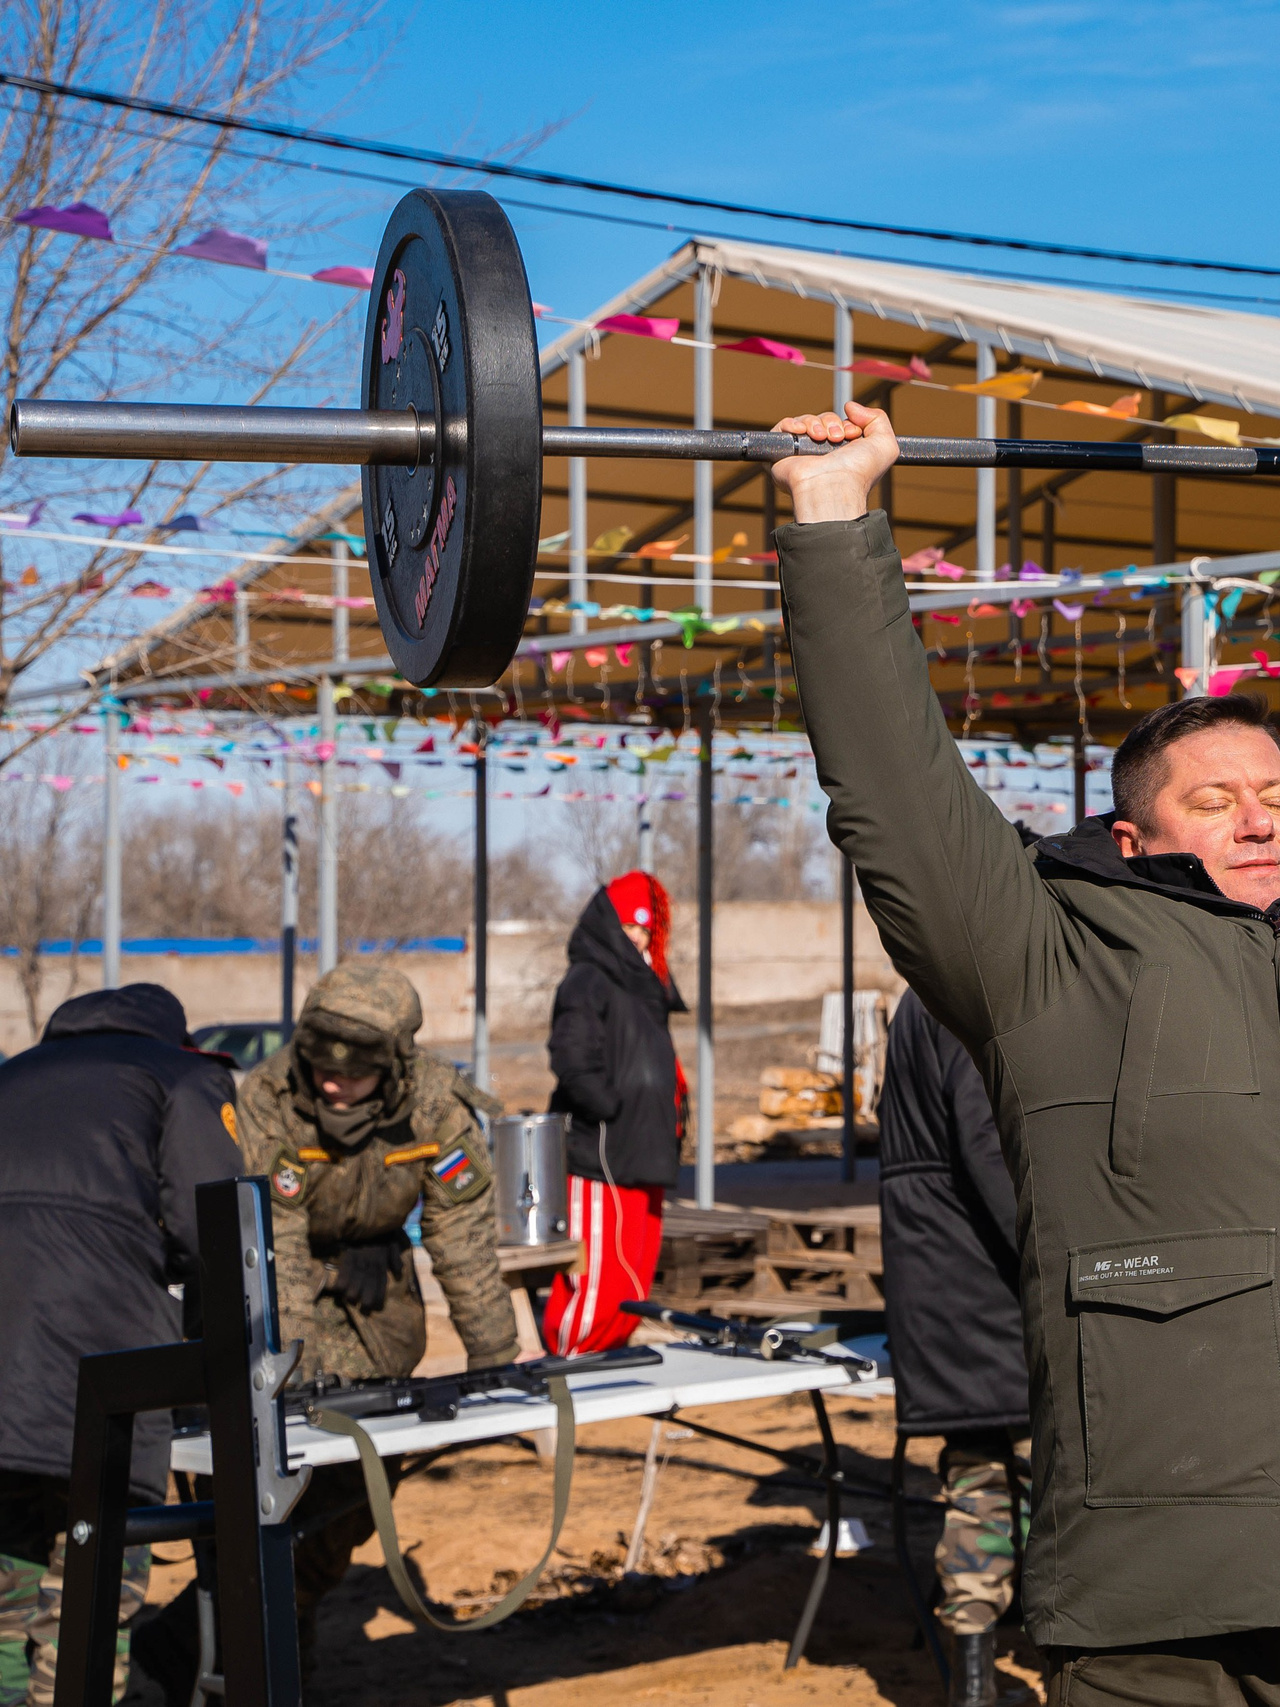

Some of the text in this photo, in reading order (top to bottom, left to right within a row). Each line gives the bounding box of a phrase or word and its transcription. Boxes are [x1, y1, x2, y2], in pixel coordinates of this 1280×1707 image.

[414, 475, 457, 630] МАГМА
[1123, 1255, 1159, 1269] WEAR
[1079, 1274, 1099, 1283] INSIDE
[1100, 1271, 1113, 1279] OUT
[1139, 1266, 1175, 1276] TEMPERAT
